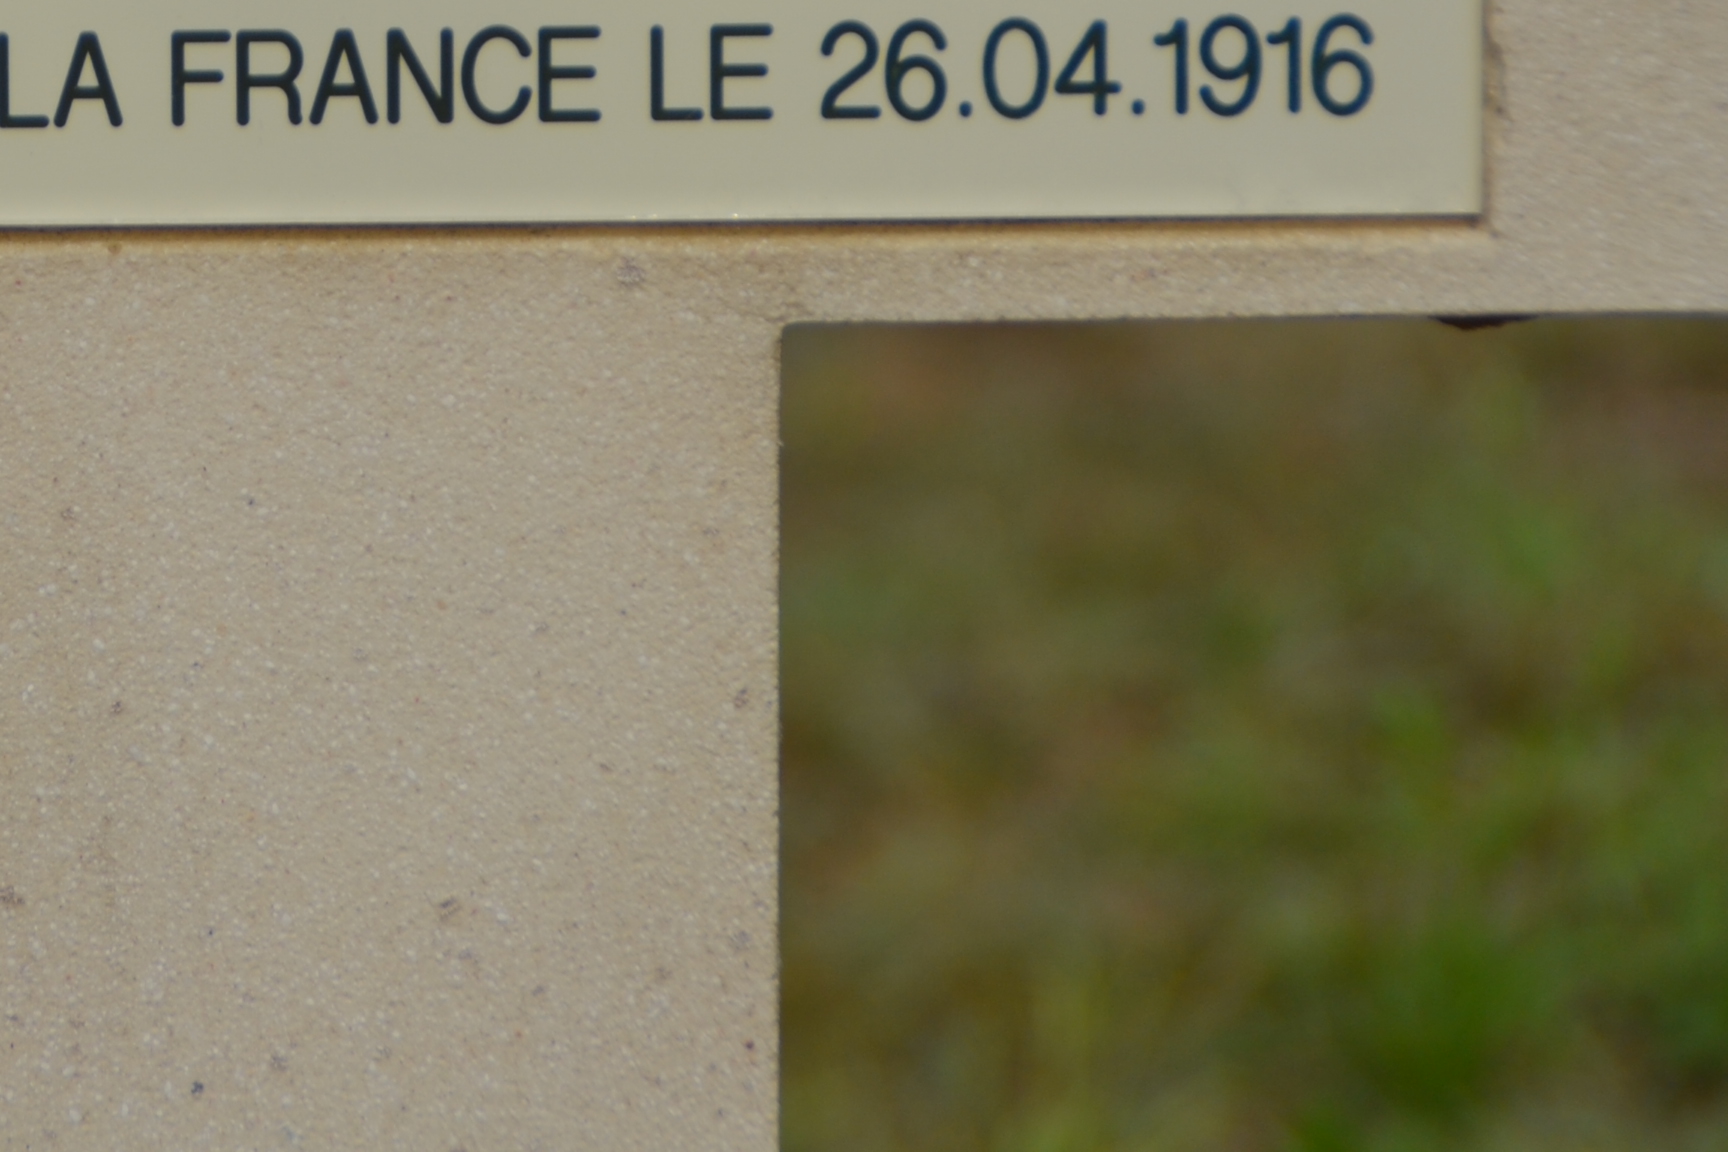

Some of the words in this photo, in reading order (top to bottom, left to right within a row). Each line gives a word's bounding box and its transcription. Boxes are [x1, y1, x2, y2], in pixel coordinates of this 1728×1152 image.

[169, 23, 604, 129] FRANCE
[648, 21, 776, 124] LE
[818, 11, 1377, 125] 26.04.1916
